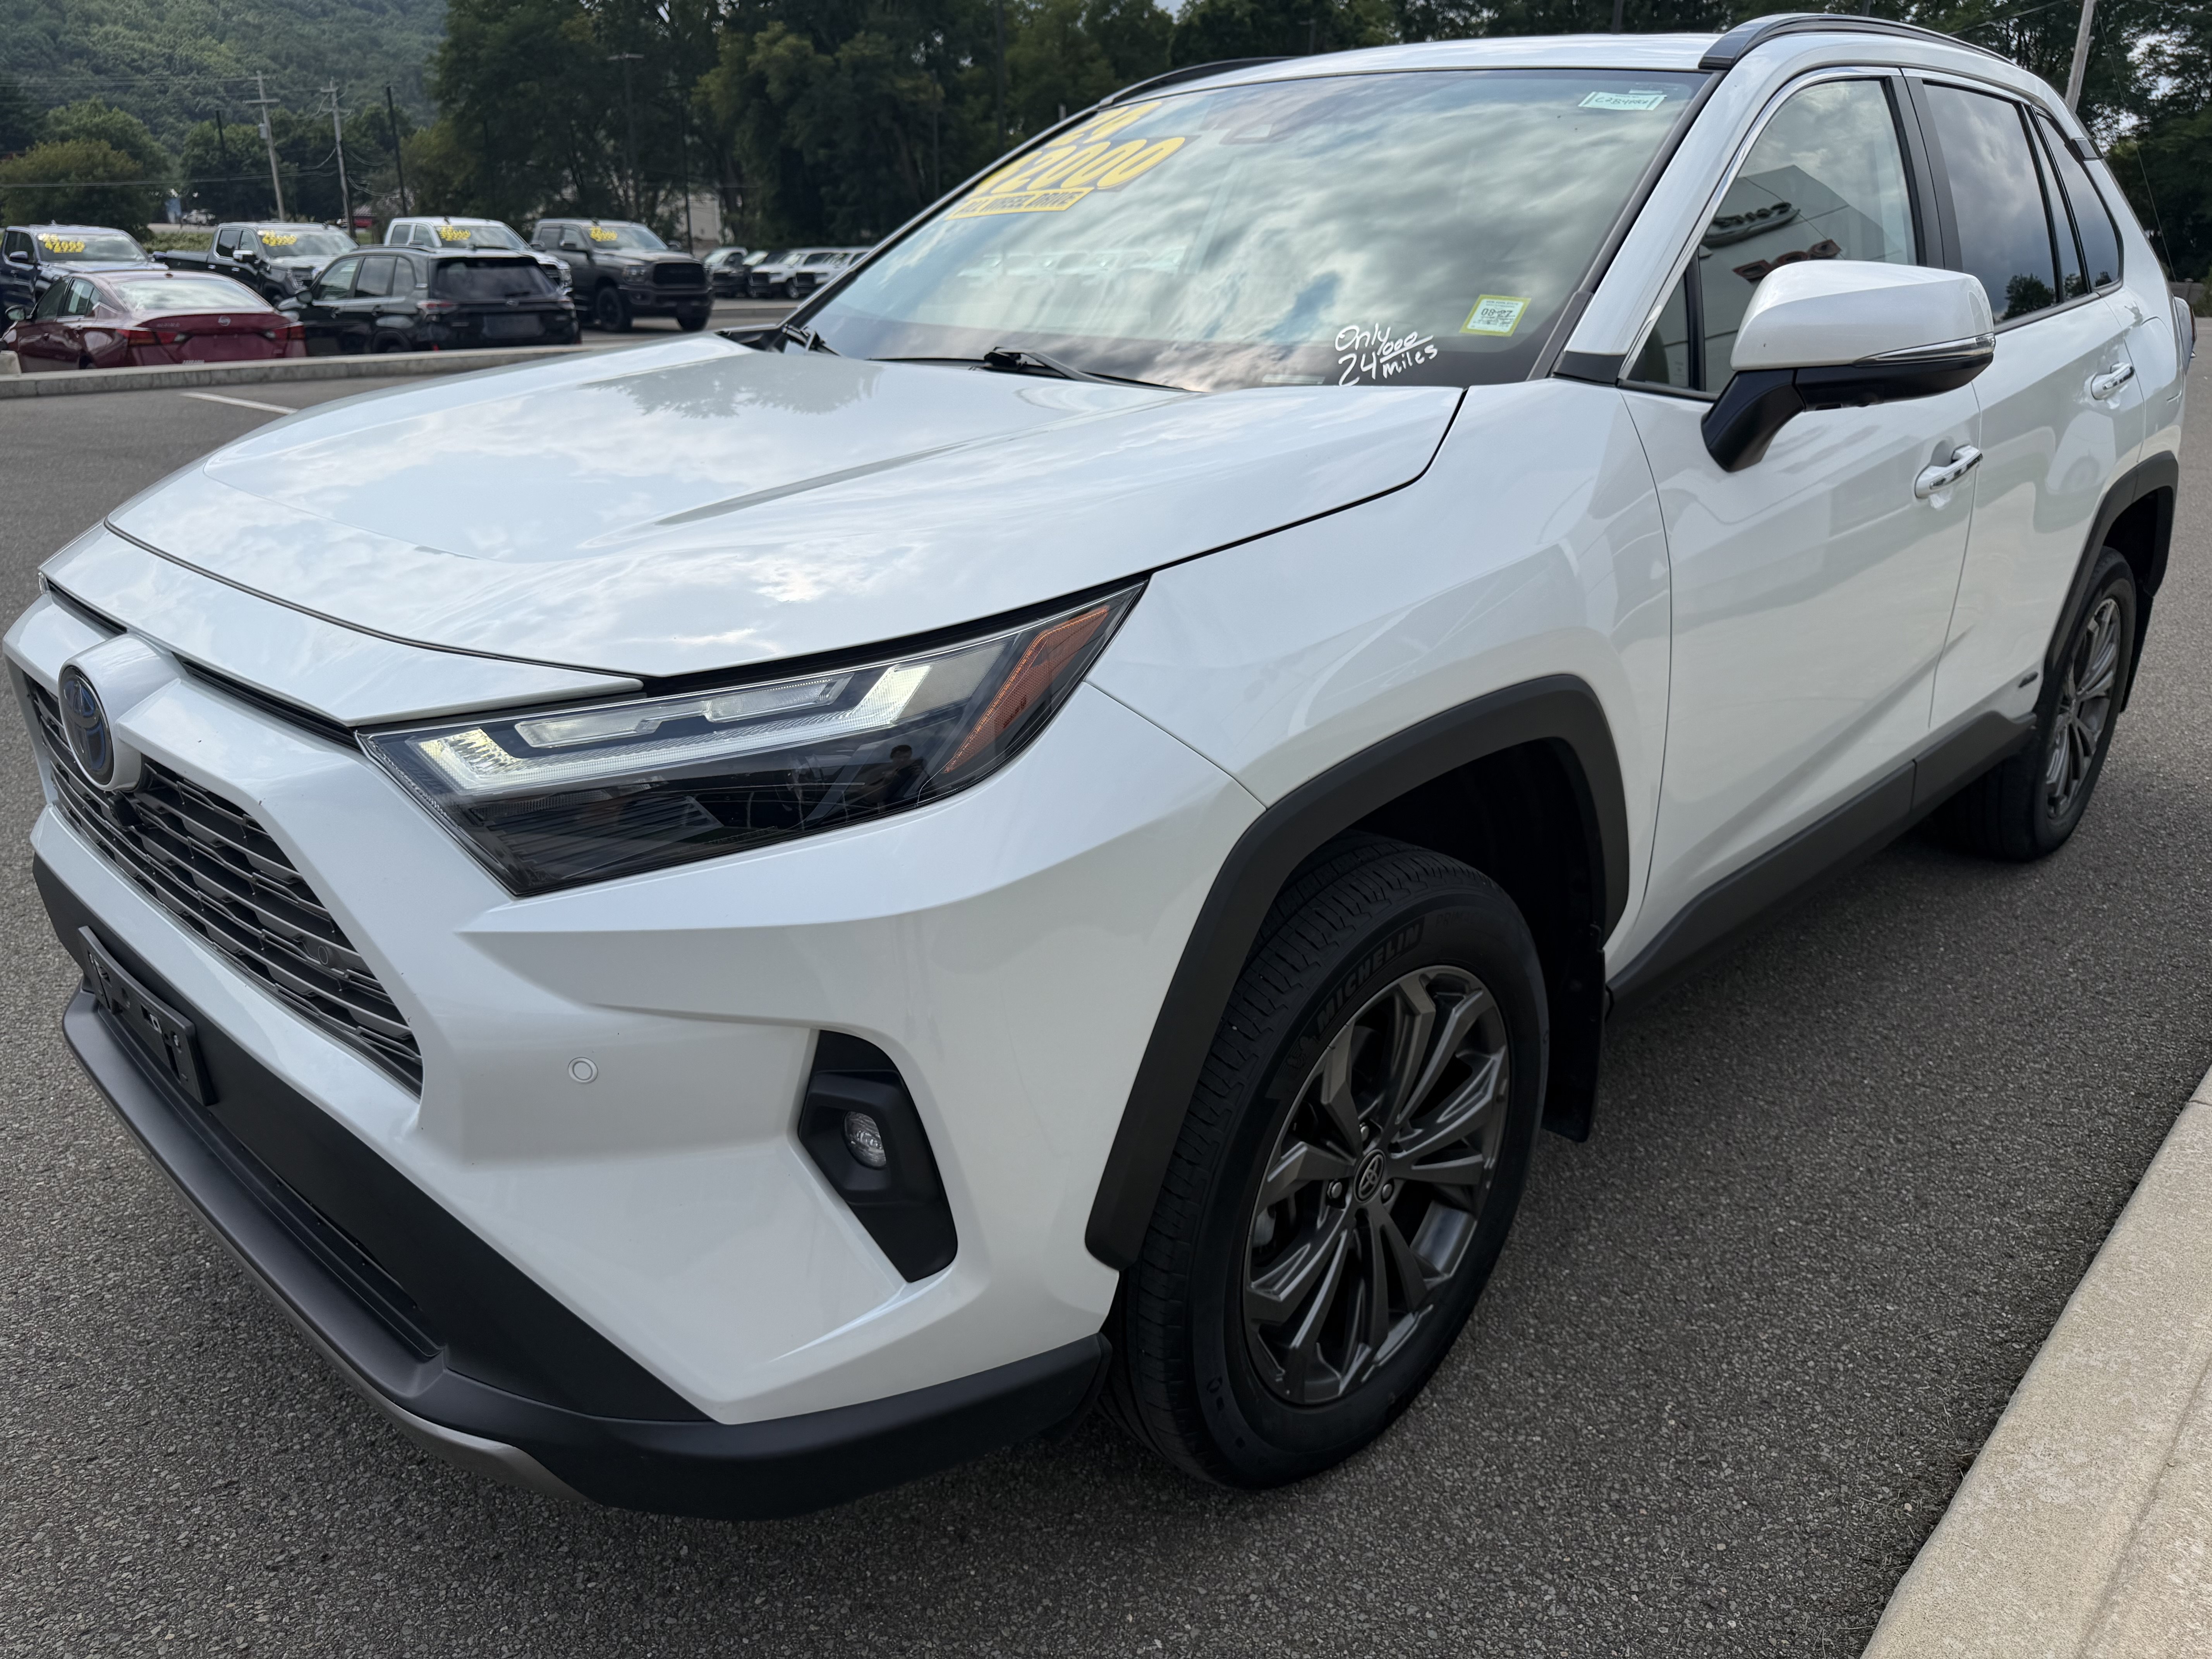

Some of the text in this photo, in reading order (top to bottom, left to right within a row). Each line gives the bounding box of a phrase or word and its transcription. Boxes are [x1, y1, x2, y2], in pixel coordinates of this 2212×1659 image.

[956, 191, 1084, 215] ALL WHEEL DRIVE
[1481, 308, 1513, 318] 08-27
[1335, 323, 1391, 356] Only
[1338, 351, 1377, 386] 24
[1382, 344, 1438, 378] miles
[1317, 923, 1421, 1035] MICHELIN
